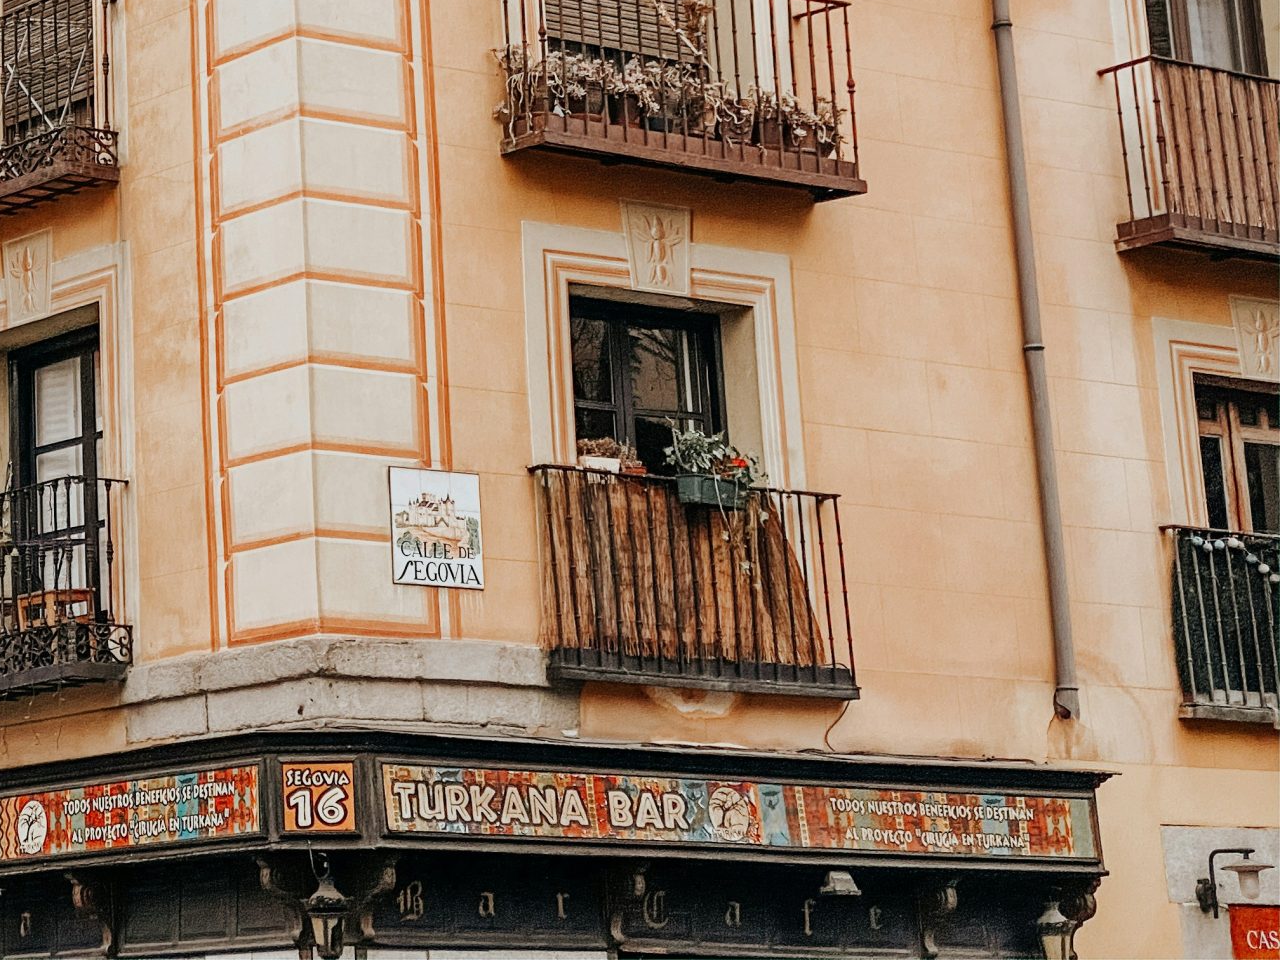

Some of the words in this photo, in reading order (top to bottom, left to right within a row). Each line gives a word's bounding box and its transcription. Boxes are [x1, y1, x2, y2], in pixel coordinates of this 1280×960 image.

[401, 540, 453, 559] CALLE
[459, 546, 476, 560] DE
[397, 560, 482, 585] SEGOVIA
[286, 769, 350, 786] SEGOVIA
[62, 800, 91, 816] TODOS
[92, 792, 133, 813] NUESTROS
[135, 787, 180, 805] BENEFICIOS
[181, 785, 192, 803] SE
[193, 781, 235, 800] DESTINAN
[288, 787, 346, 827] 16
[393, 782, 589, 829] TURKANA
[607, 791, 689, 830] BAR
[829, 798, 865, 815] TODOS
[867, 801, 918, 817] NUESTROS
[919, 803, 972, 820] BENEFICIOS
[973, 805, 985, 821] SE
[986, 806, 1034, 823] DESTINAN
[71, 830, 83, 843] AL
[84, 823, 128, 841] PROYECTO
[169, 820, 180, 833] EN
[845, 828, 860, 840] AL
[861, 828, 913, 845] PROYECTO
[961, 833, 974, 846] EN
